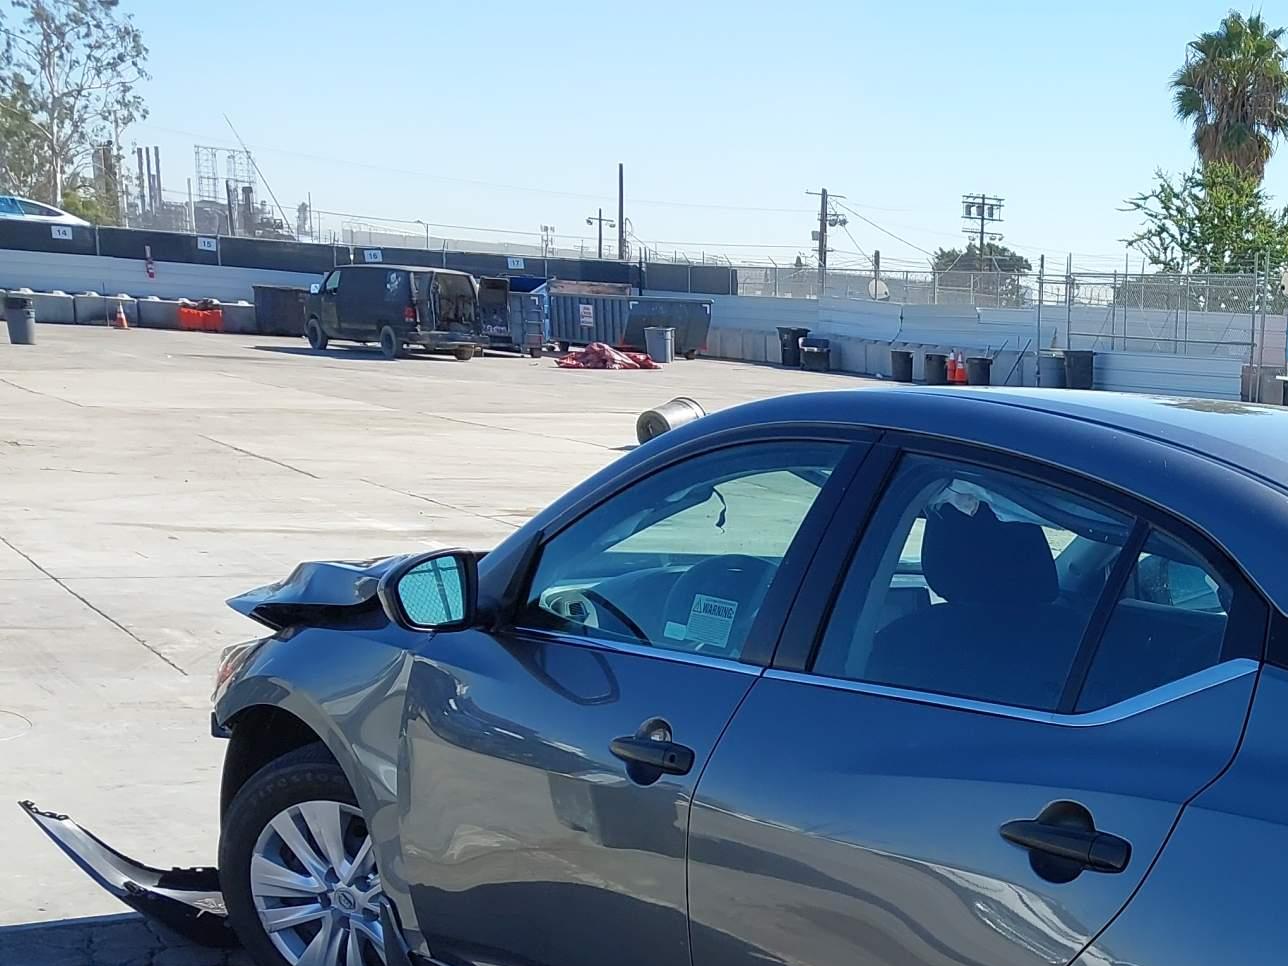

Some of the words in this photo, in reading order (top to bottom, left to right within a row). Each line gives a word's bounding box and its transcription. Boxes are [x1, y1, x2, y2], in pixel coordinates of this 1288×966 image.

[56, 229, 67, 237] 14
[202, 240, 212, 248] 15
[368, 252, 378, 260] 16
